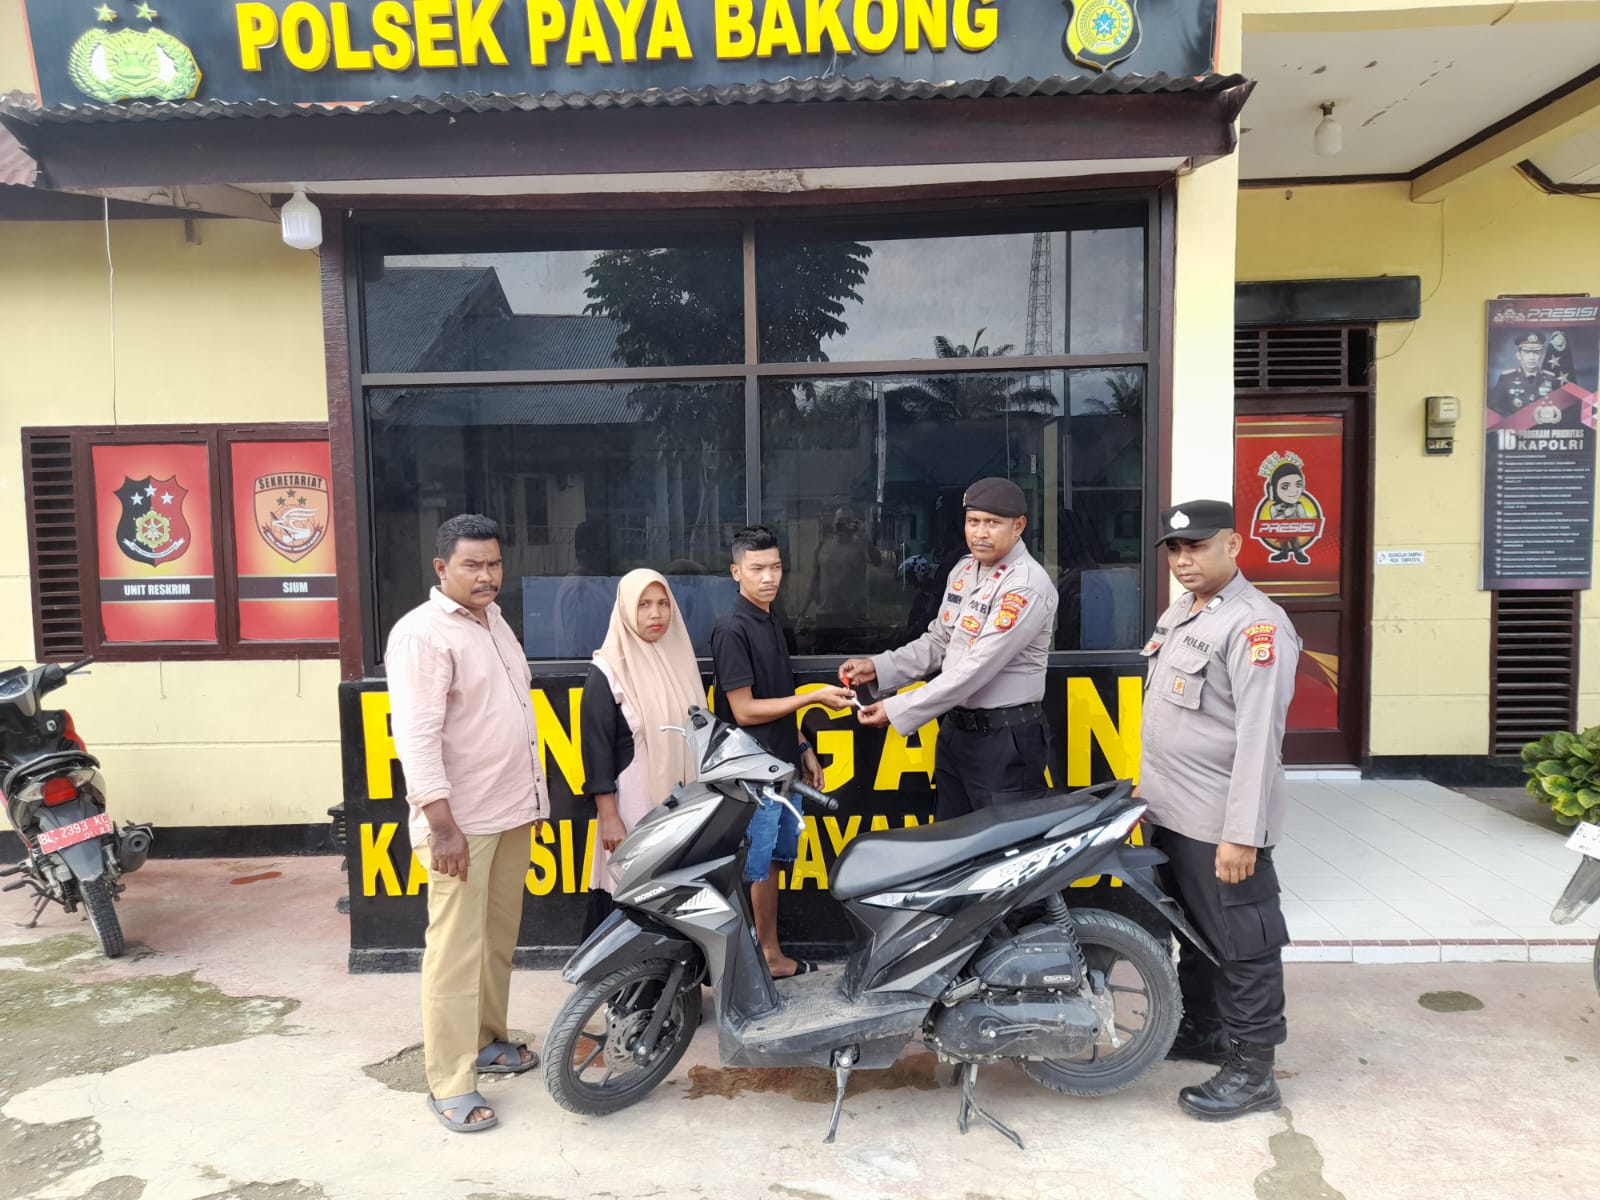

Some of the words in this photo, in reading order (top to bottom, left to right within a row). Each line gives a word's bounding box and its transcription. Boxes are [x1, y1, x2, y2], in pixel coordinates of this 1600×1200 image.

[237, 0, 509, 73] POLSEK
[528, 0, 693, 65] PAYA
[716, 0, 999, 59] BAKONG
[1526, 306, 1598, 318] PRESISI
[1497, 428, 1516, 450] 16
[1518, 439, 1583, 451] KAPOLRI
[258, 475, 323, 490] SEKRETARIAT
[1258, 521, 1316, 533] PRESISI
[123, 584, 146, 596] UNIT
[148, 584, 191, 595] RESKRIM
[282, 582, 308, 593] SIUM
[1183, 636, 1210, 653] POLRI
[61, 822, 89, 838] 2393
[634, 886, 667, 903] HONDA
